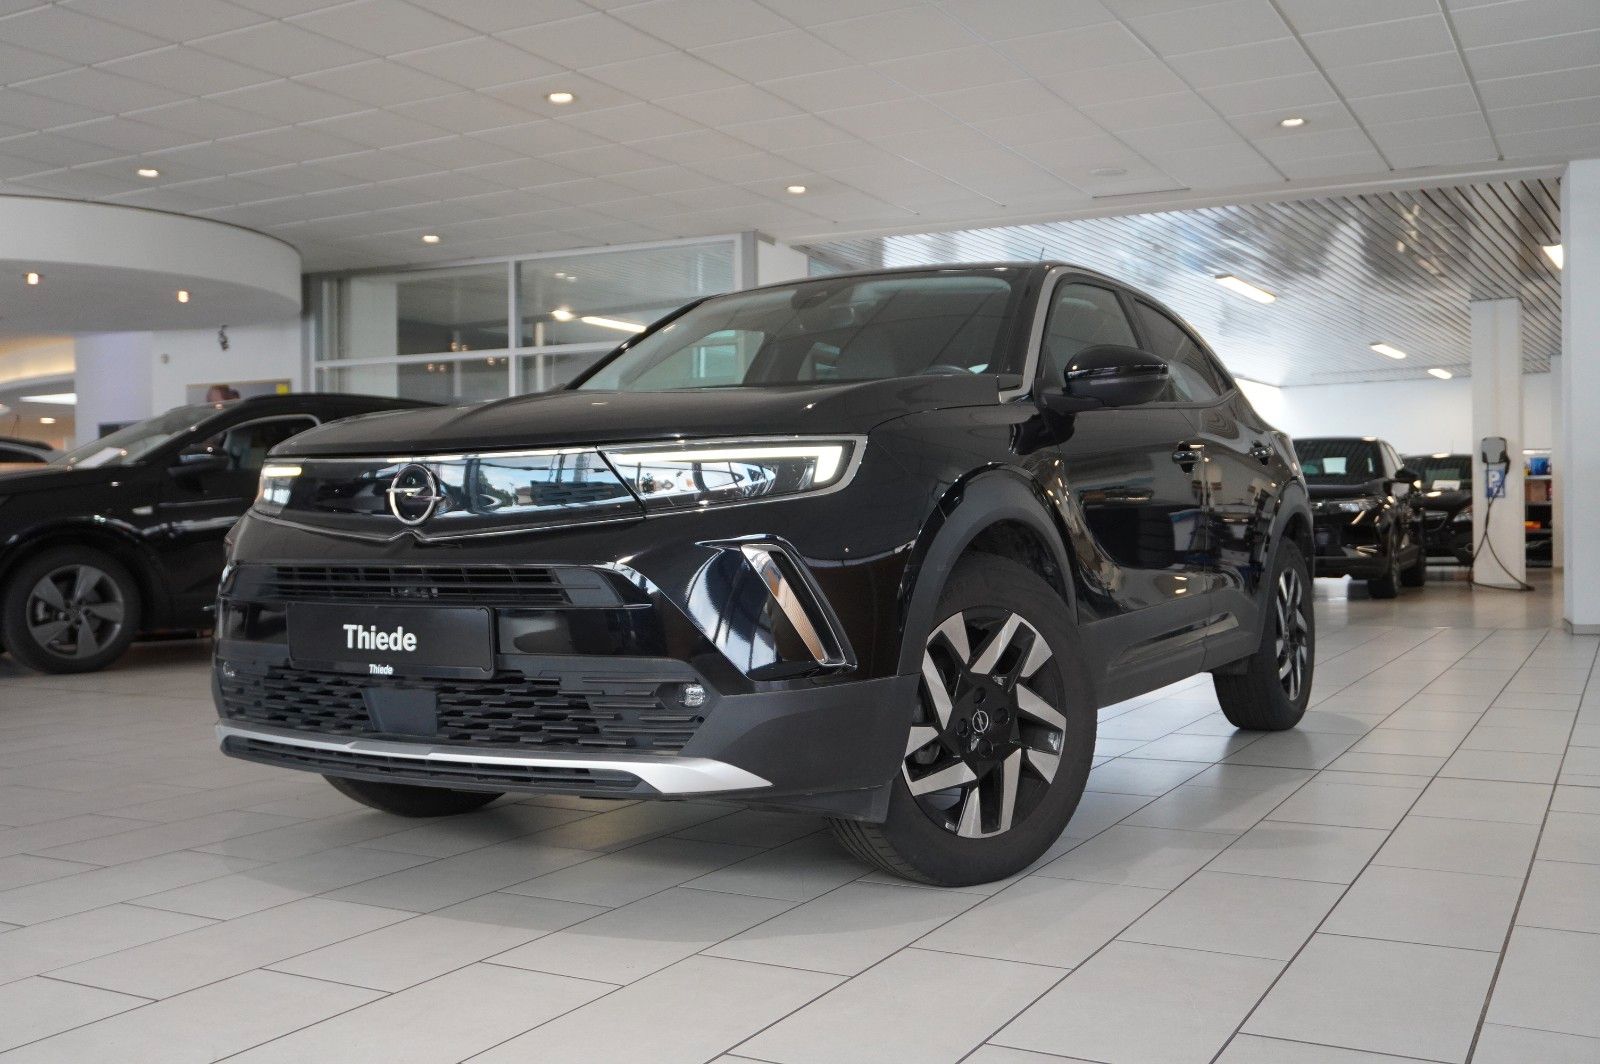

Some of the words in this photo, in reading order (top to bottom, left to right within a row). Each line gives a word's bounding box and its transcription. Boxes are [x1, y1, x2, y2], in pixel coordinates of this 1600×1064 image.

[1488, 470, 1500, 488] P
[343, 624, 417, 652] Thiede
[368, 663, 394, 675] Thiede
